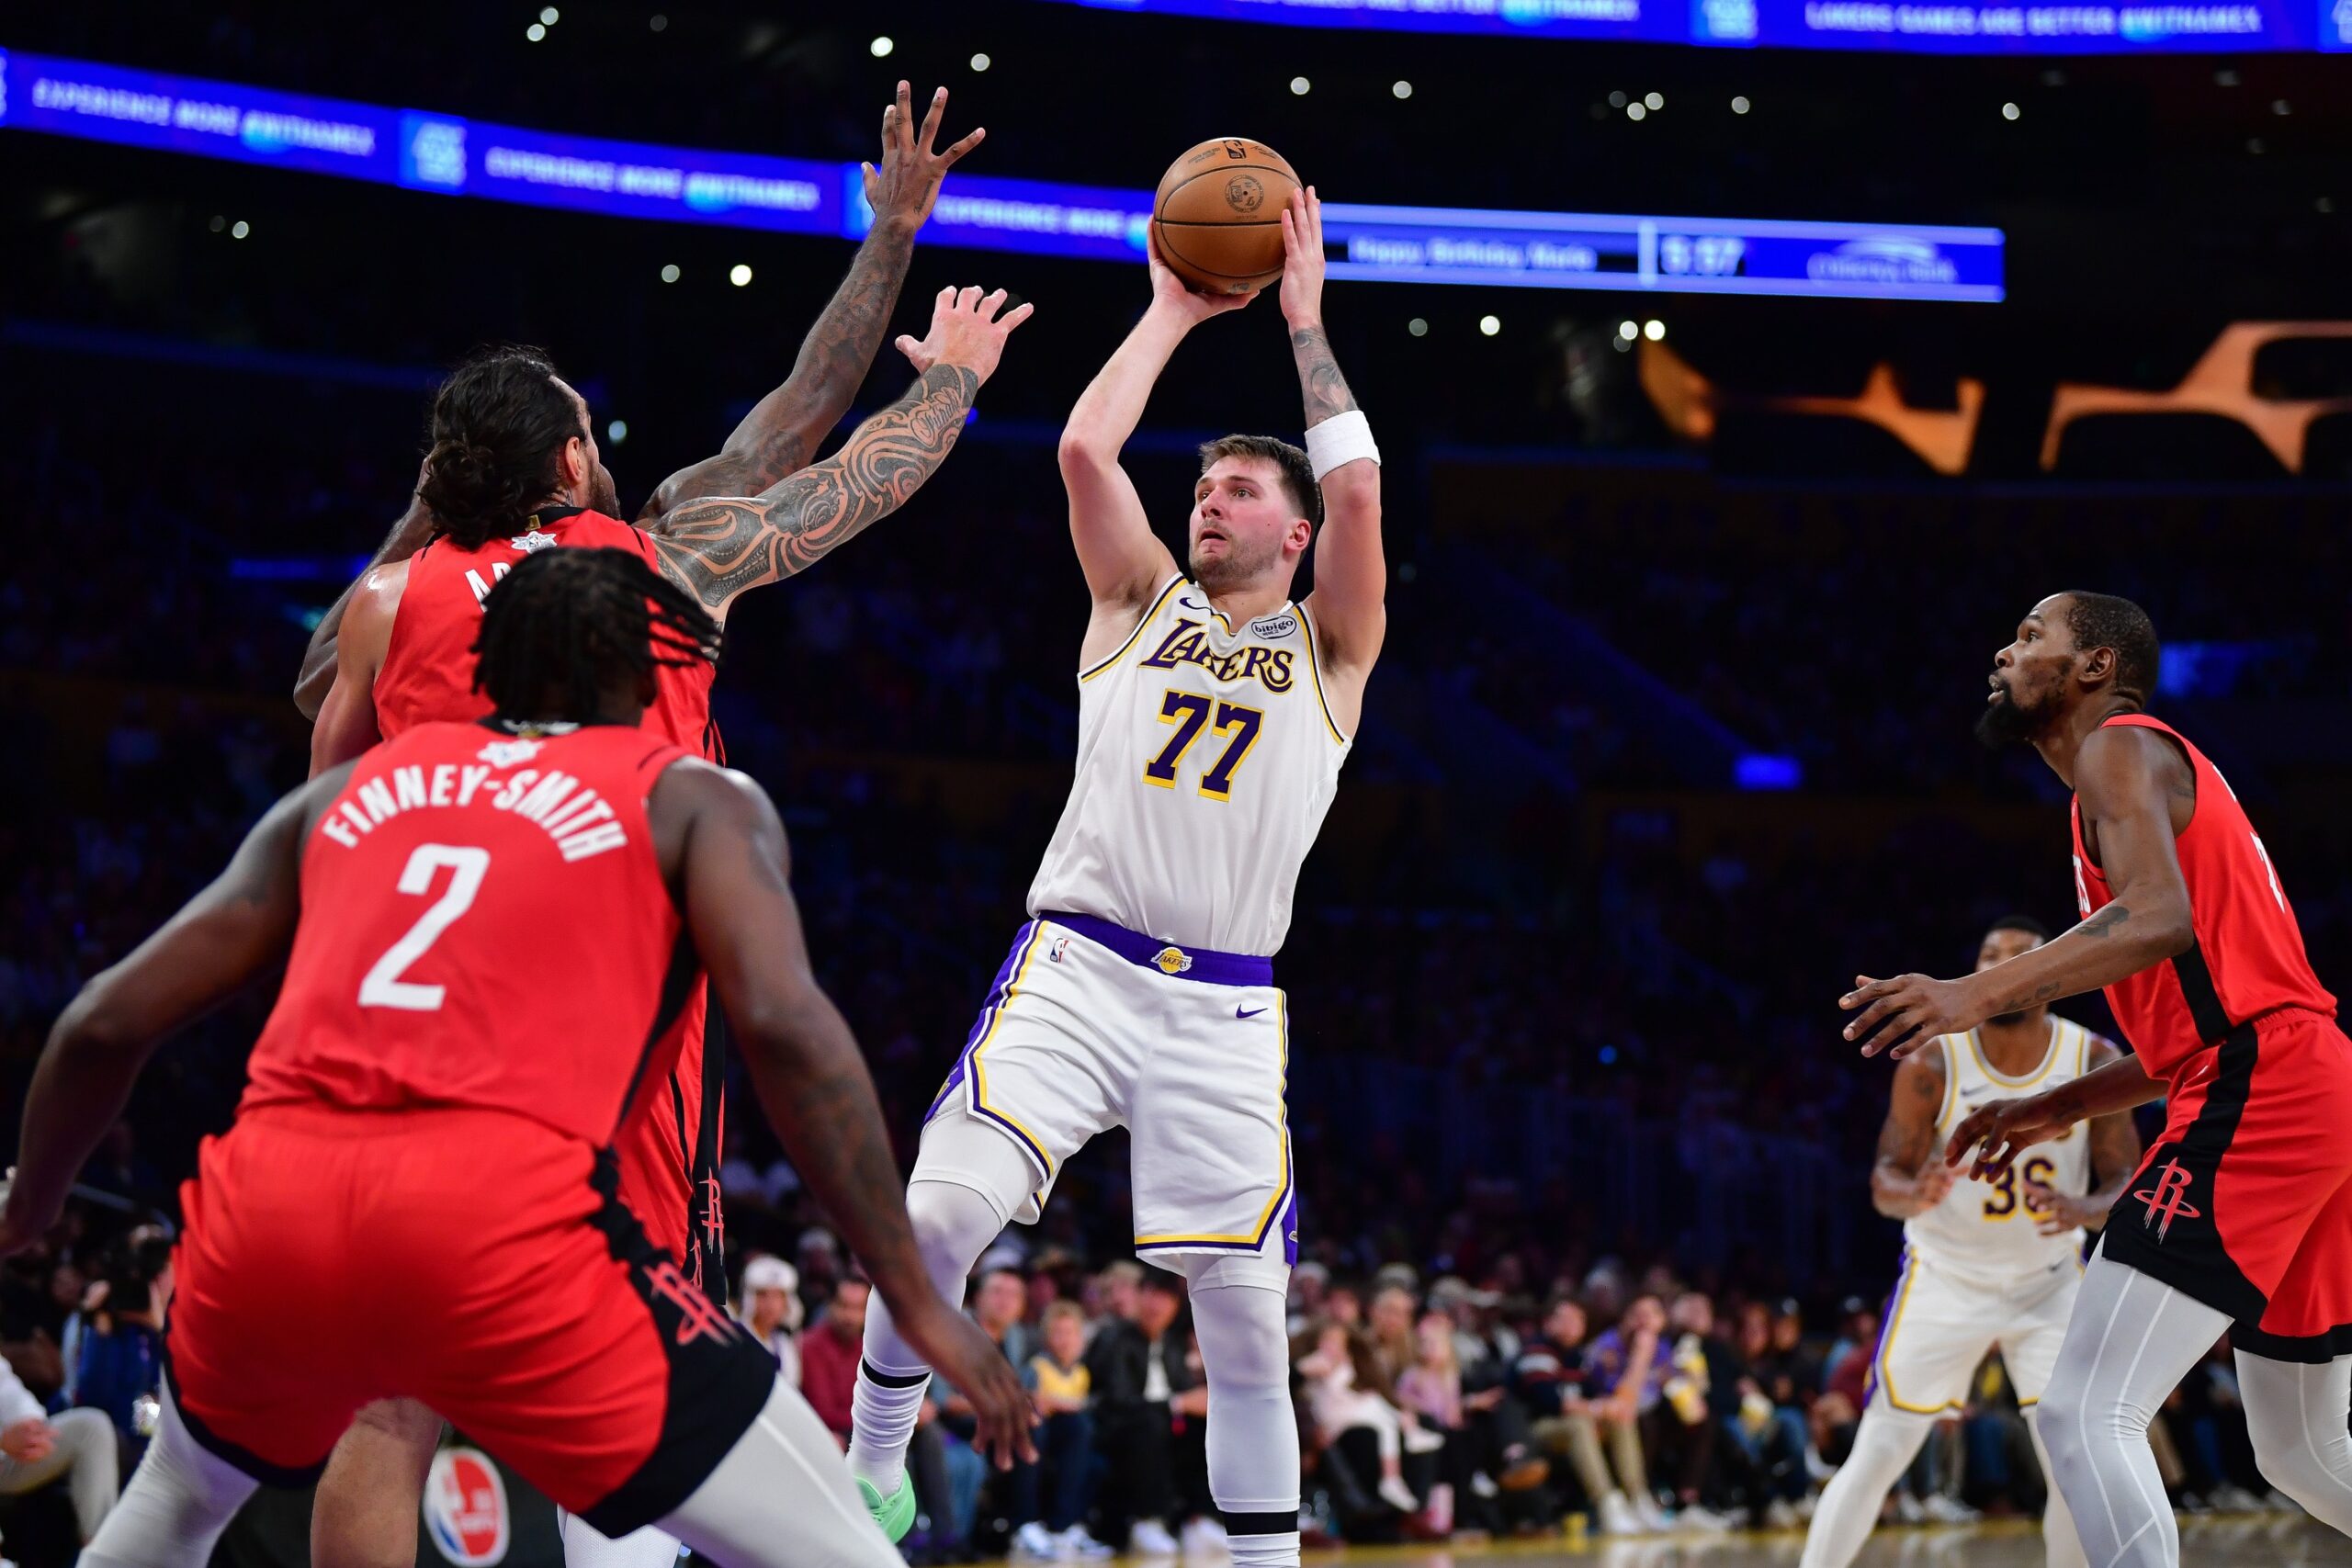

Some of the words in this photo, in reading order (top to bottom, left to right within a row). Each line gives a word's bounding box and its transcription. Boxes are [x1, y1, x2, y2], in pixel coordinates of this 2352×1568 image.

[1137, 618, 1295, 694] LAKERS
[1254, 620, 1294, 633] bibigo
[1143, 688, 1264, 802] 77
[322, 764, 628, 863] FINNEY-SMITH
[357, 842, 491, 1010] 2
